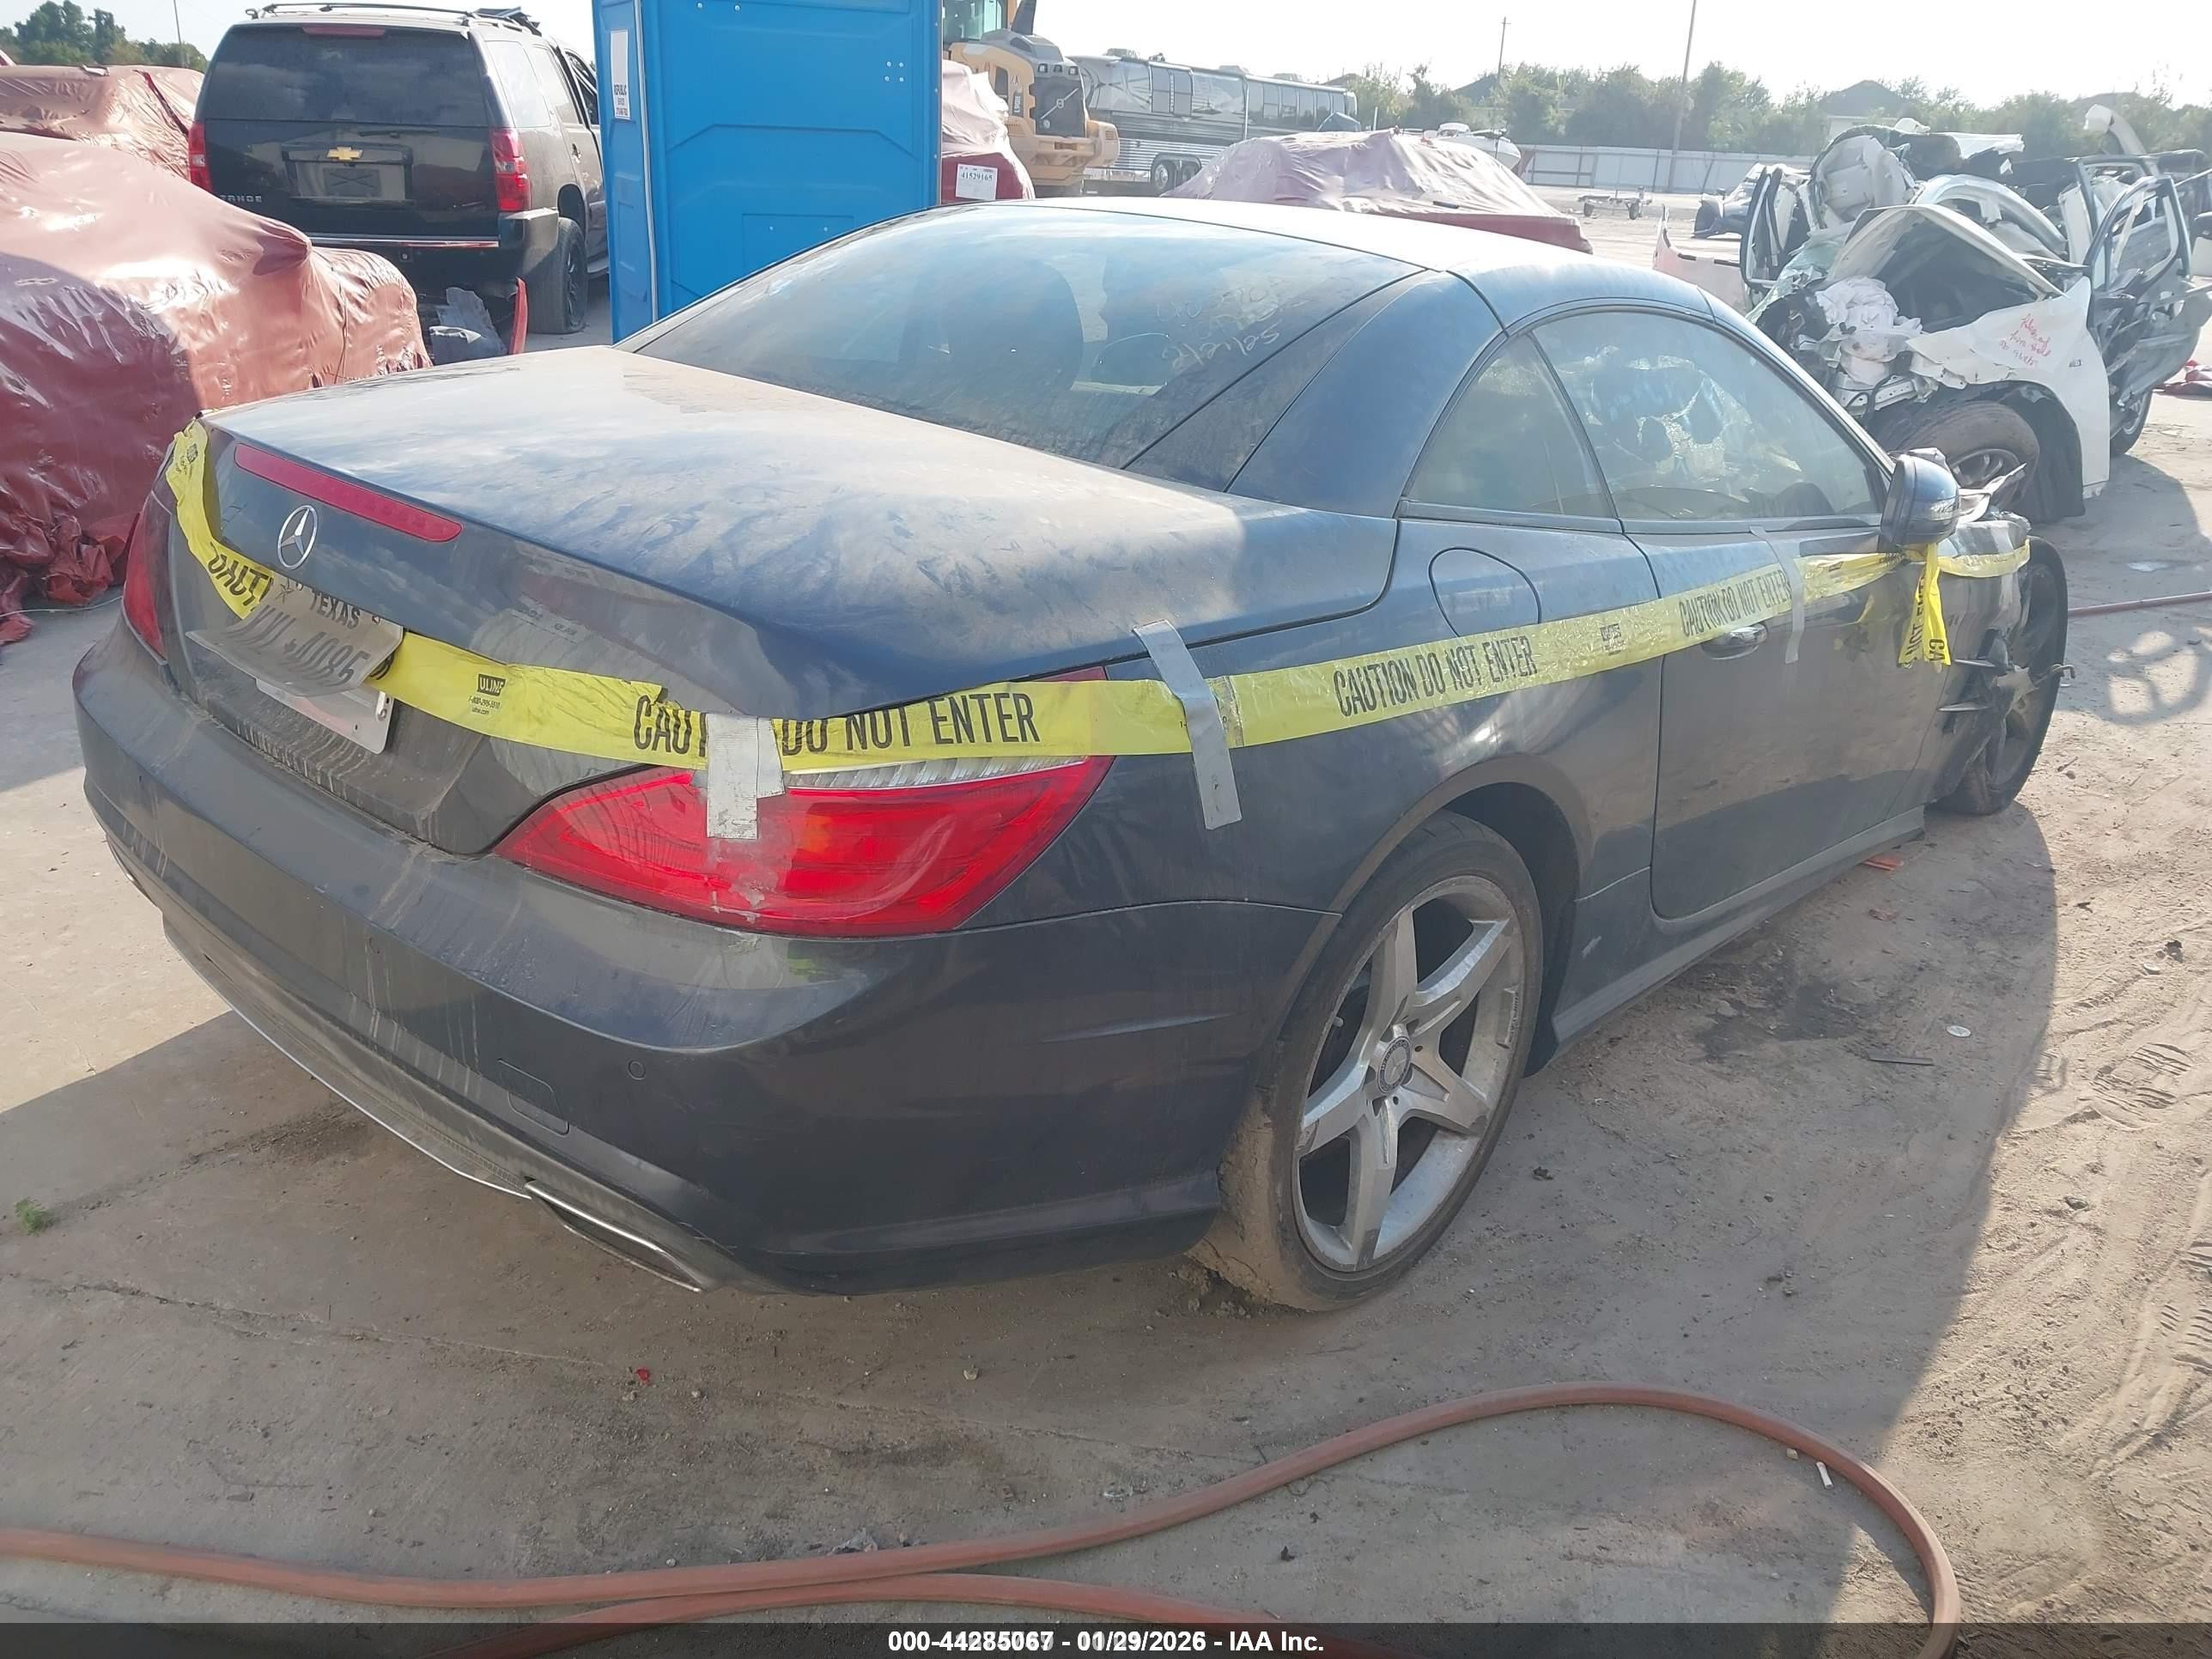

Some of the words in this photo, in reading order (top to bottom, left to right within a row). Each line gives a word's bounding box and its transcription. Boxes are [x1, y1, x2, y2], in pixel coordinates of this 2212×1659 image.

[310, 589, 360, 629] TEXAS
[1679, 591, 1729, 637] CAUTION
[1722, 586, 1741, 622] DO
[1735, 579, 1761, 617] NOT
[1757, 569, 1793, 609] ENTER
[478, 676, 505, 694] ULINE
[1334, 658, 1421, 718] CAUTION
[1414, 652, 1446, 697] DO
[1444, 645, 1483, 691] NOT
[1482, 635, 1538, 683] ENTER
[782, 718, 829, 756] DO
[846, 706, 911, 750] NOT
[927, 693, 1041, 744] ENTER
